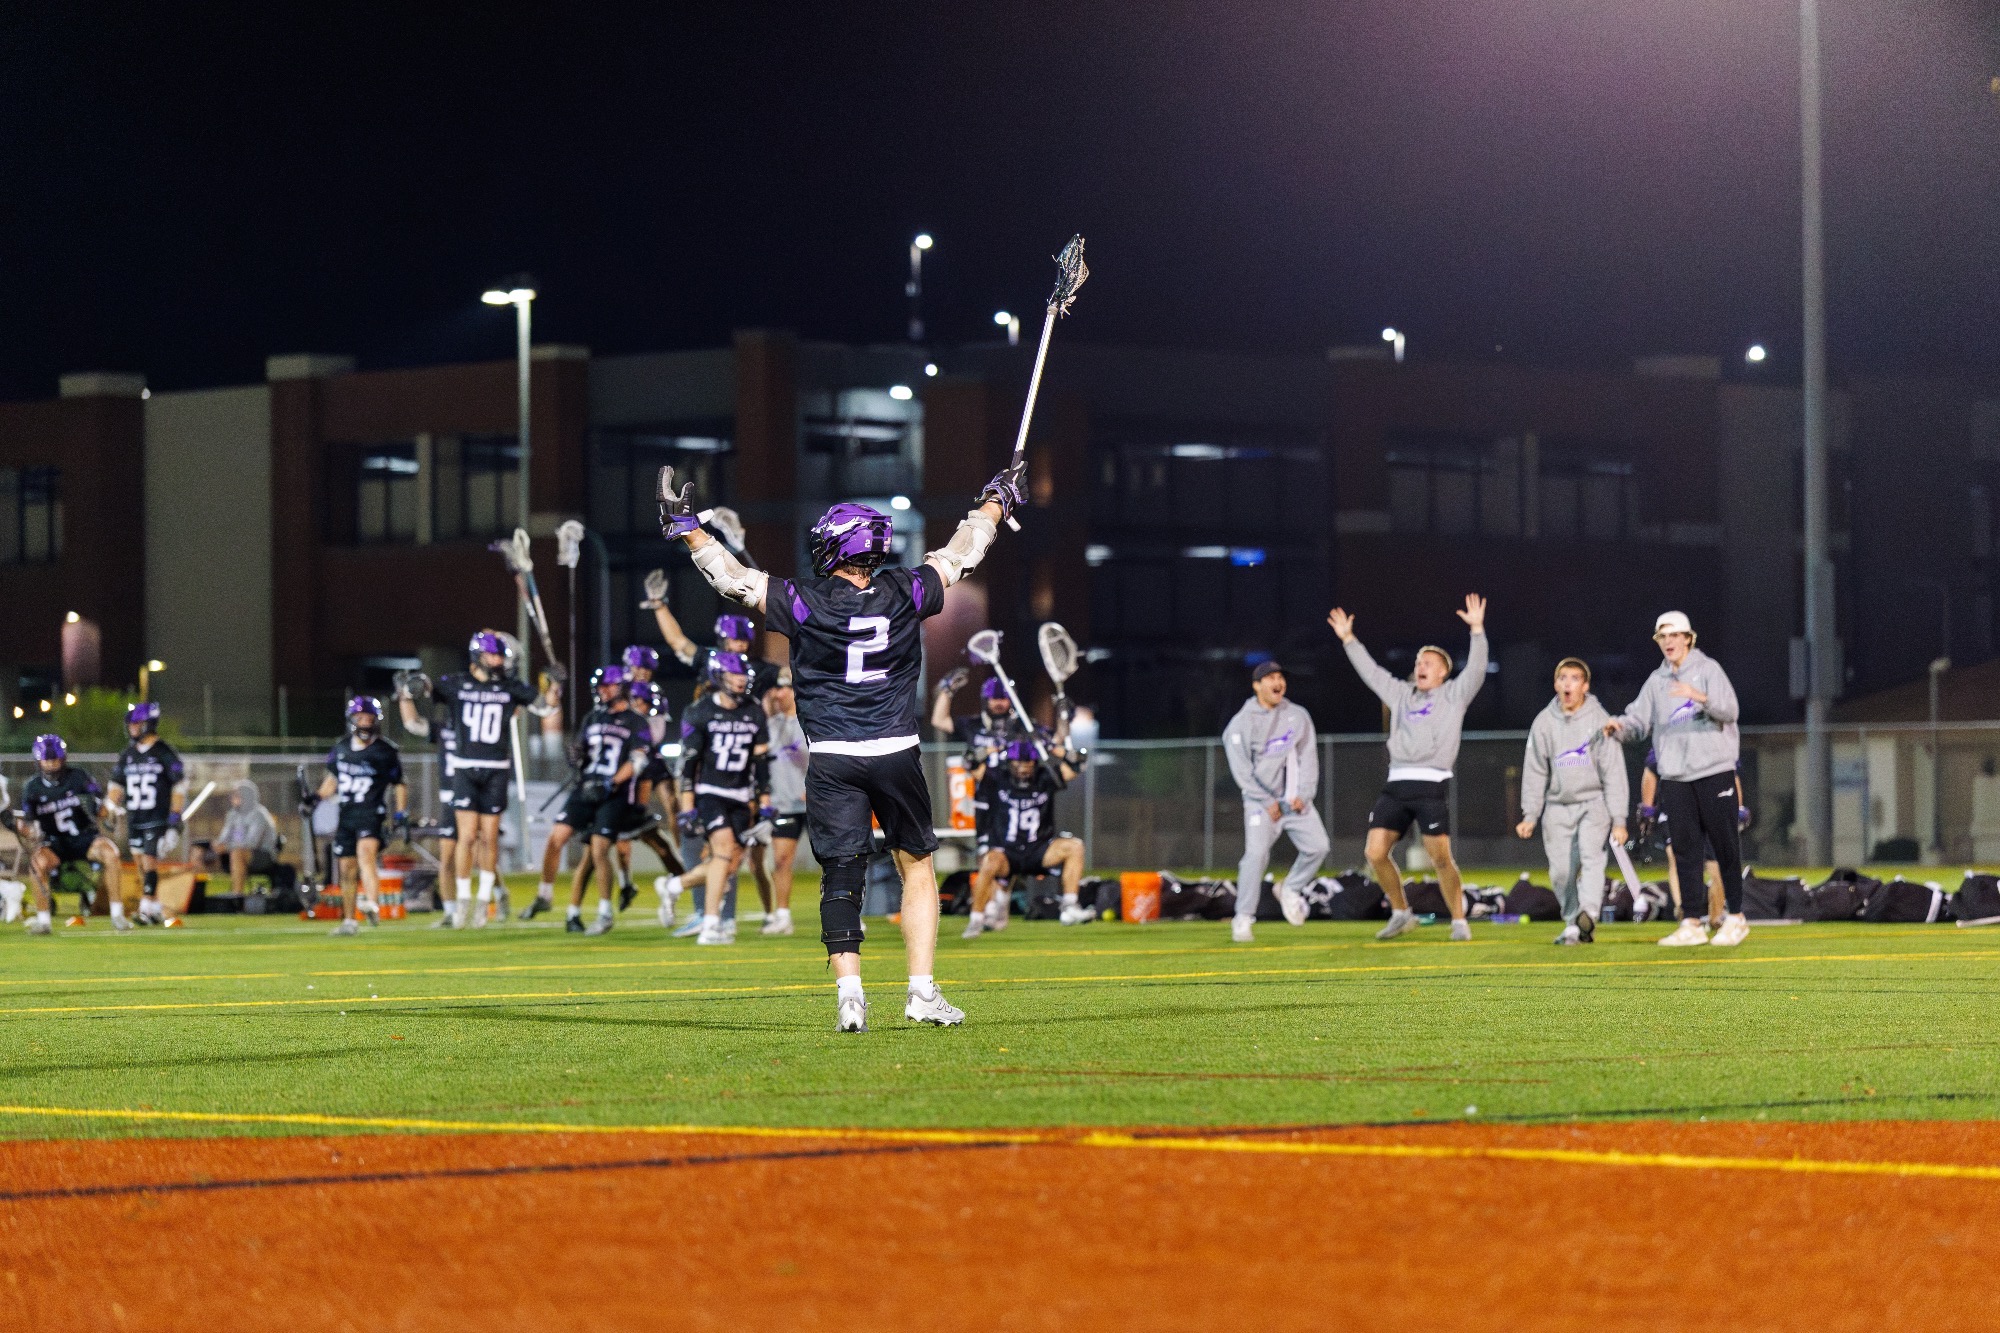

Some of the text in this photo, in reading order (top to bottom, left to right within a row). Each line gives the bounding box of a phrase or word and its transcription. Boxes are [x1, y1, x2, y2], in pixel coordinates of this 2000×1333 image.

[846, 616, 890, 684] 2
[462, 702, 503, 744] 40
[711, 733, 753, 772] 45
[126, 773, 157, 810] 55
[1006, 807, 1040, 843] 19
